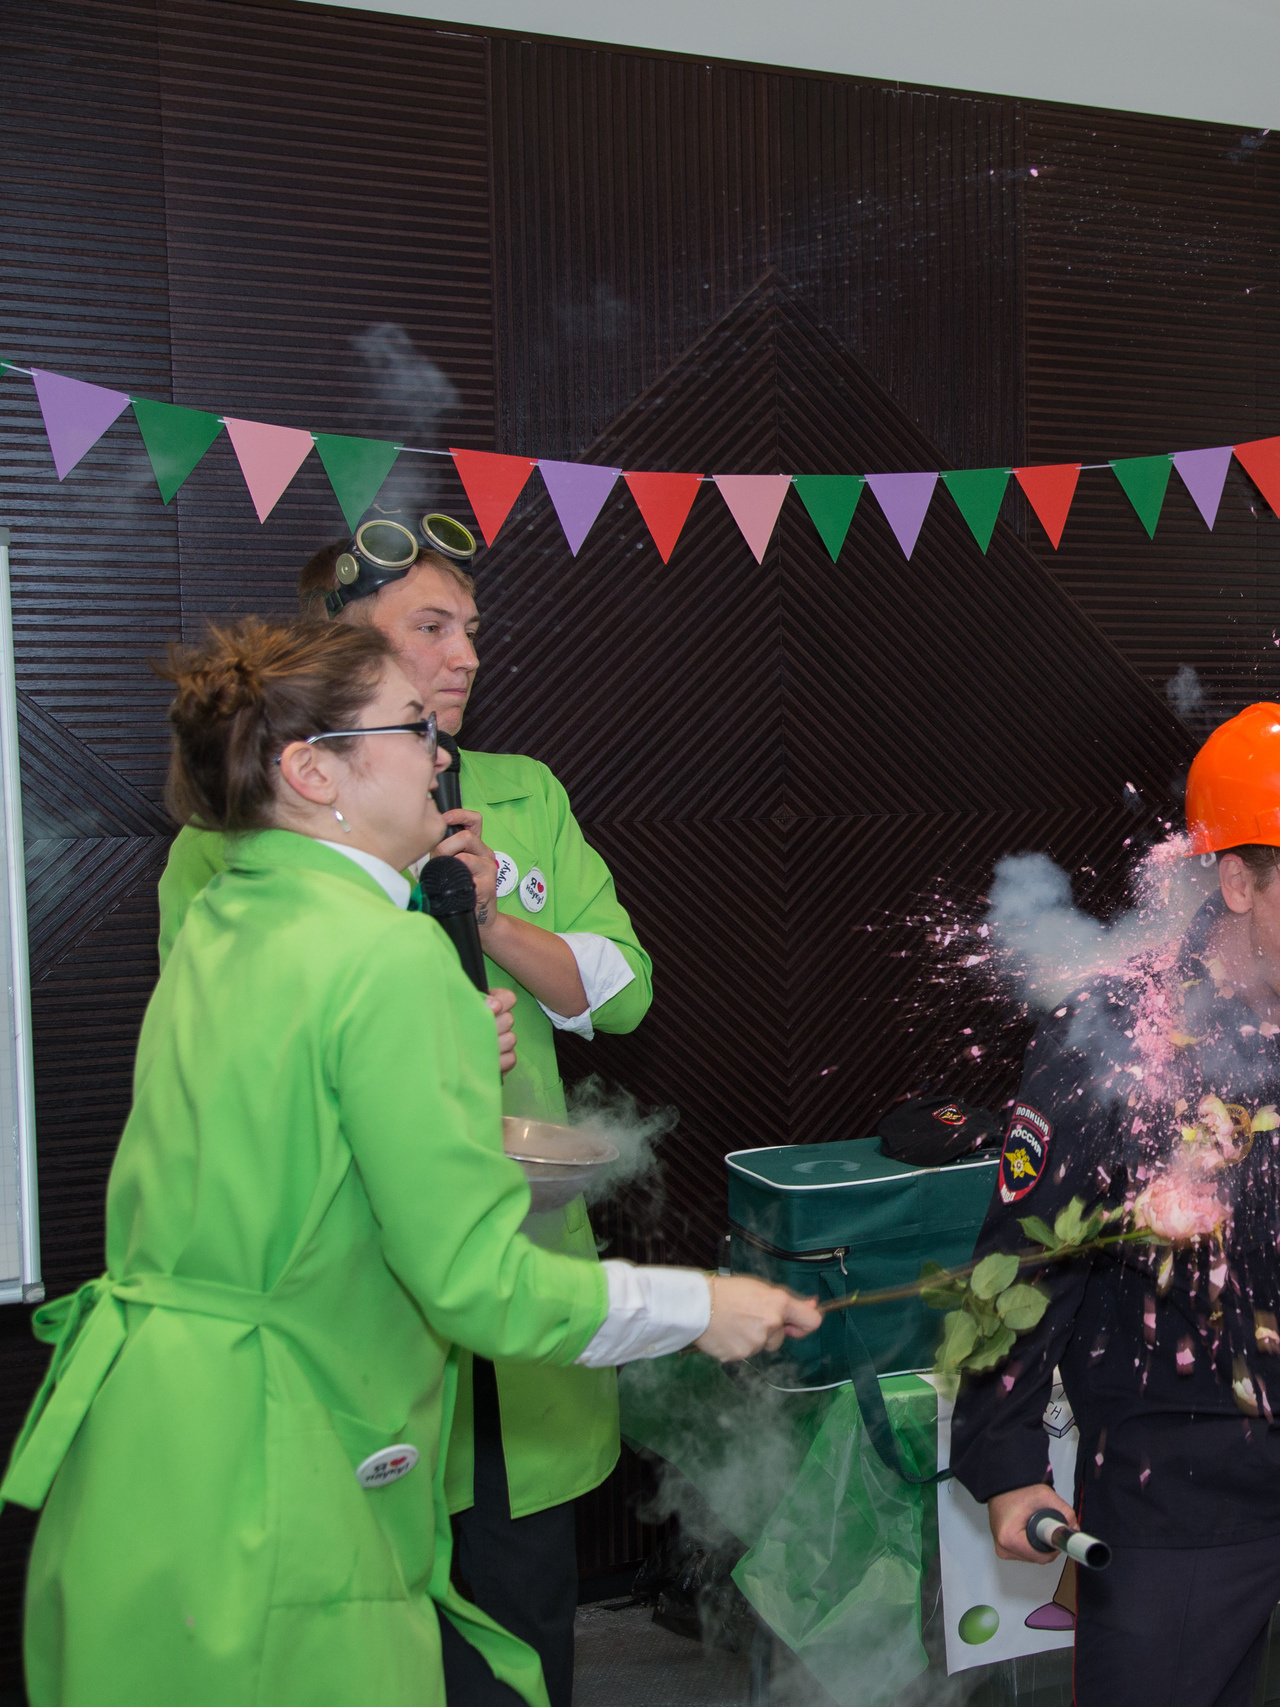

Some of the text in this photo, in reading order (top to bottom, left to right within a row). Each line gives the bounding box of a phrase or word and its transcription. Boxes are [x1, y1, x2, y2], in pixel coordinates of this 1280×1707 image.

[496, 860, 511, 890] ауку!
[531, 877, 537, 888] Я
[1016, 1106, 1049, 1136] ПОЛИЦИЯ
[1010, 1128, 1042, 1158] РОССИЯ
[1001, 1184, 1016, 1203] МВД
